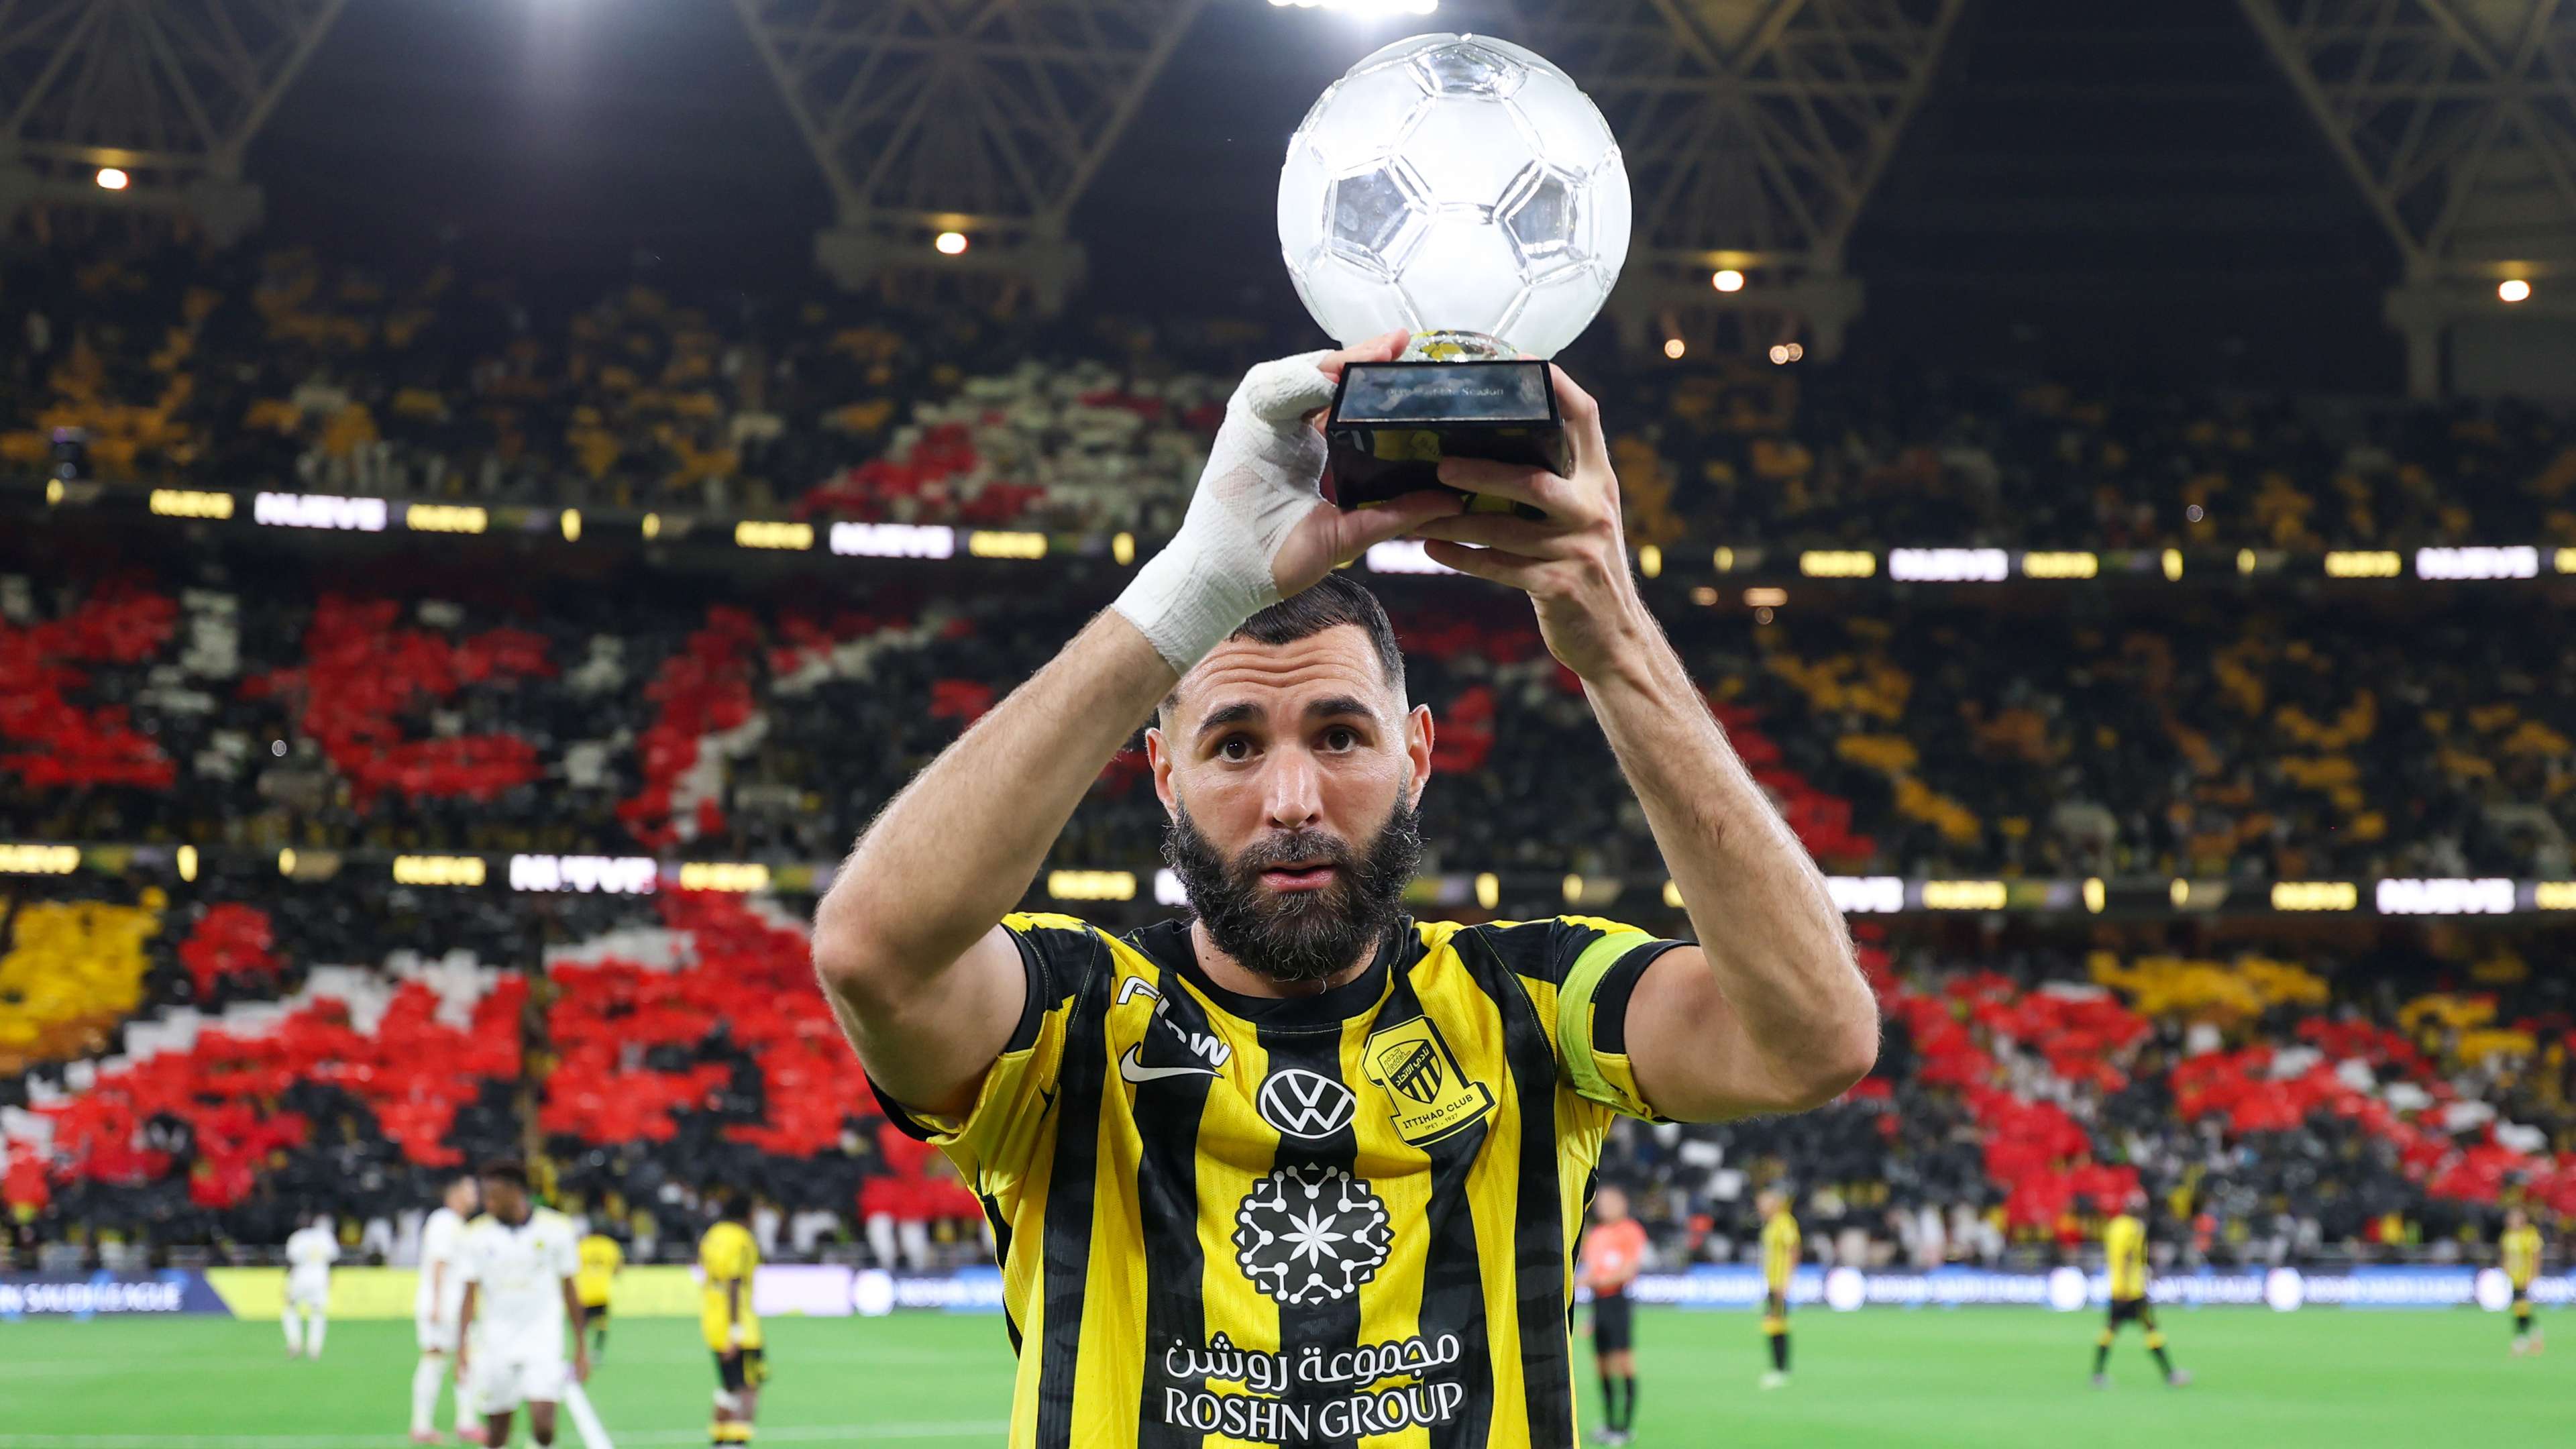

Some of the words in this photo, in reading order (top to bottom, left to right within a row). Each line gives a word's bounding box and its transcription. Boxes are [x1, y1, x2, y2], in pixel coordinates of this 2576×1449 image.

[1403, 1109, 1444, 1128] ITTIHAD
[1446, 1094, 1473, 1112] CLUB
[1445, 1113, 1458, 1122] 1927
[1166, 1336, 1288, 1391] روشن
[1298, 1334, 1460, 1385] مجموعة
[1165, 1387, 1311, 1440] ROSHN
[1320, 1383, 1462, 1438] GROUP
